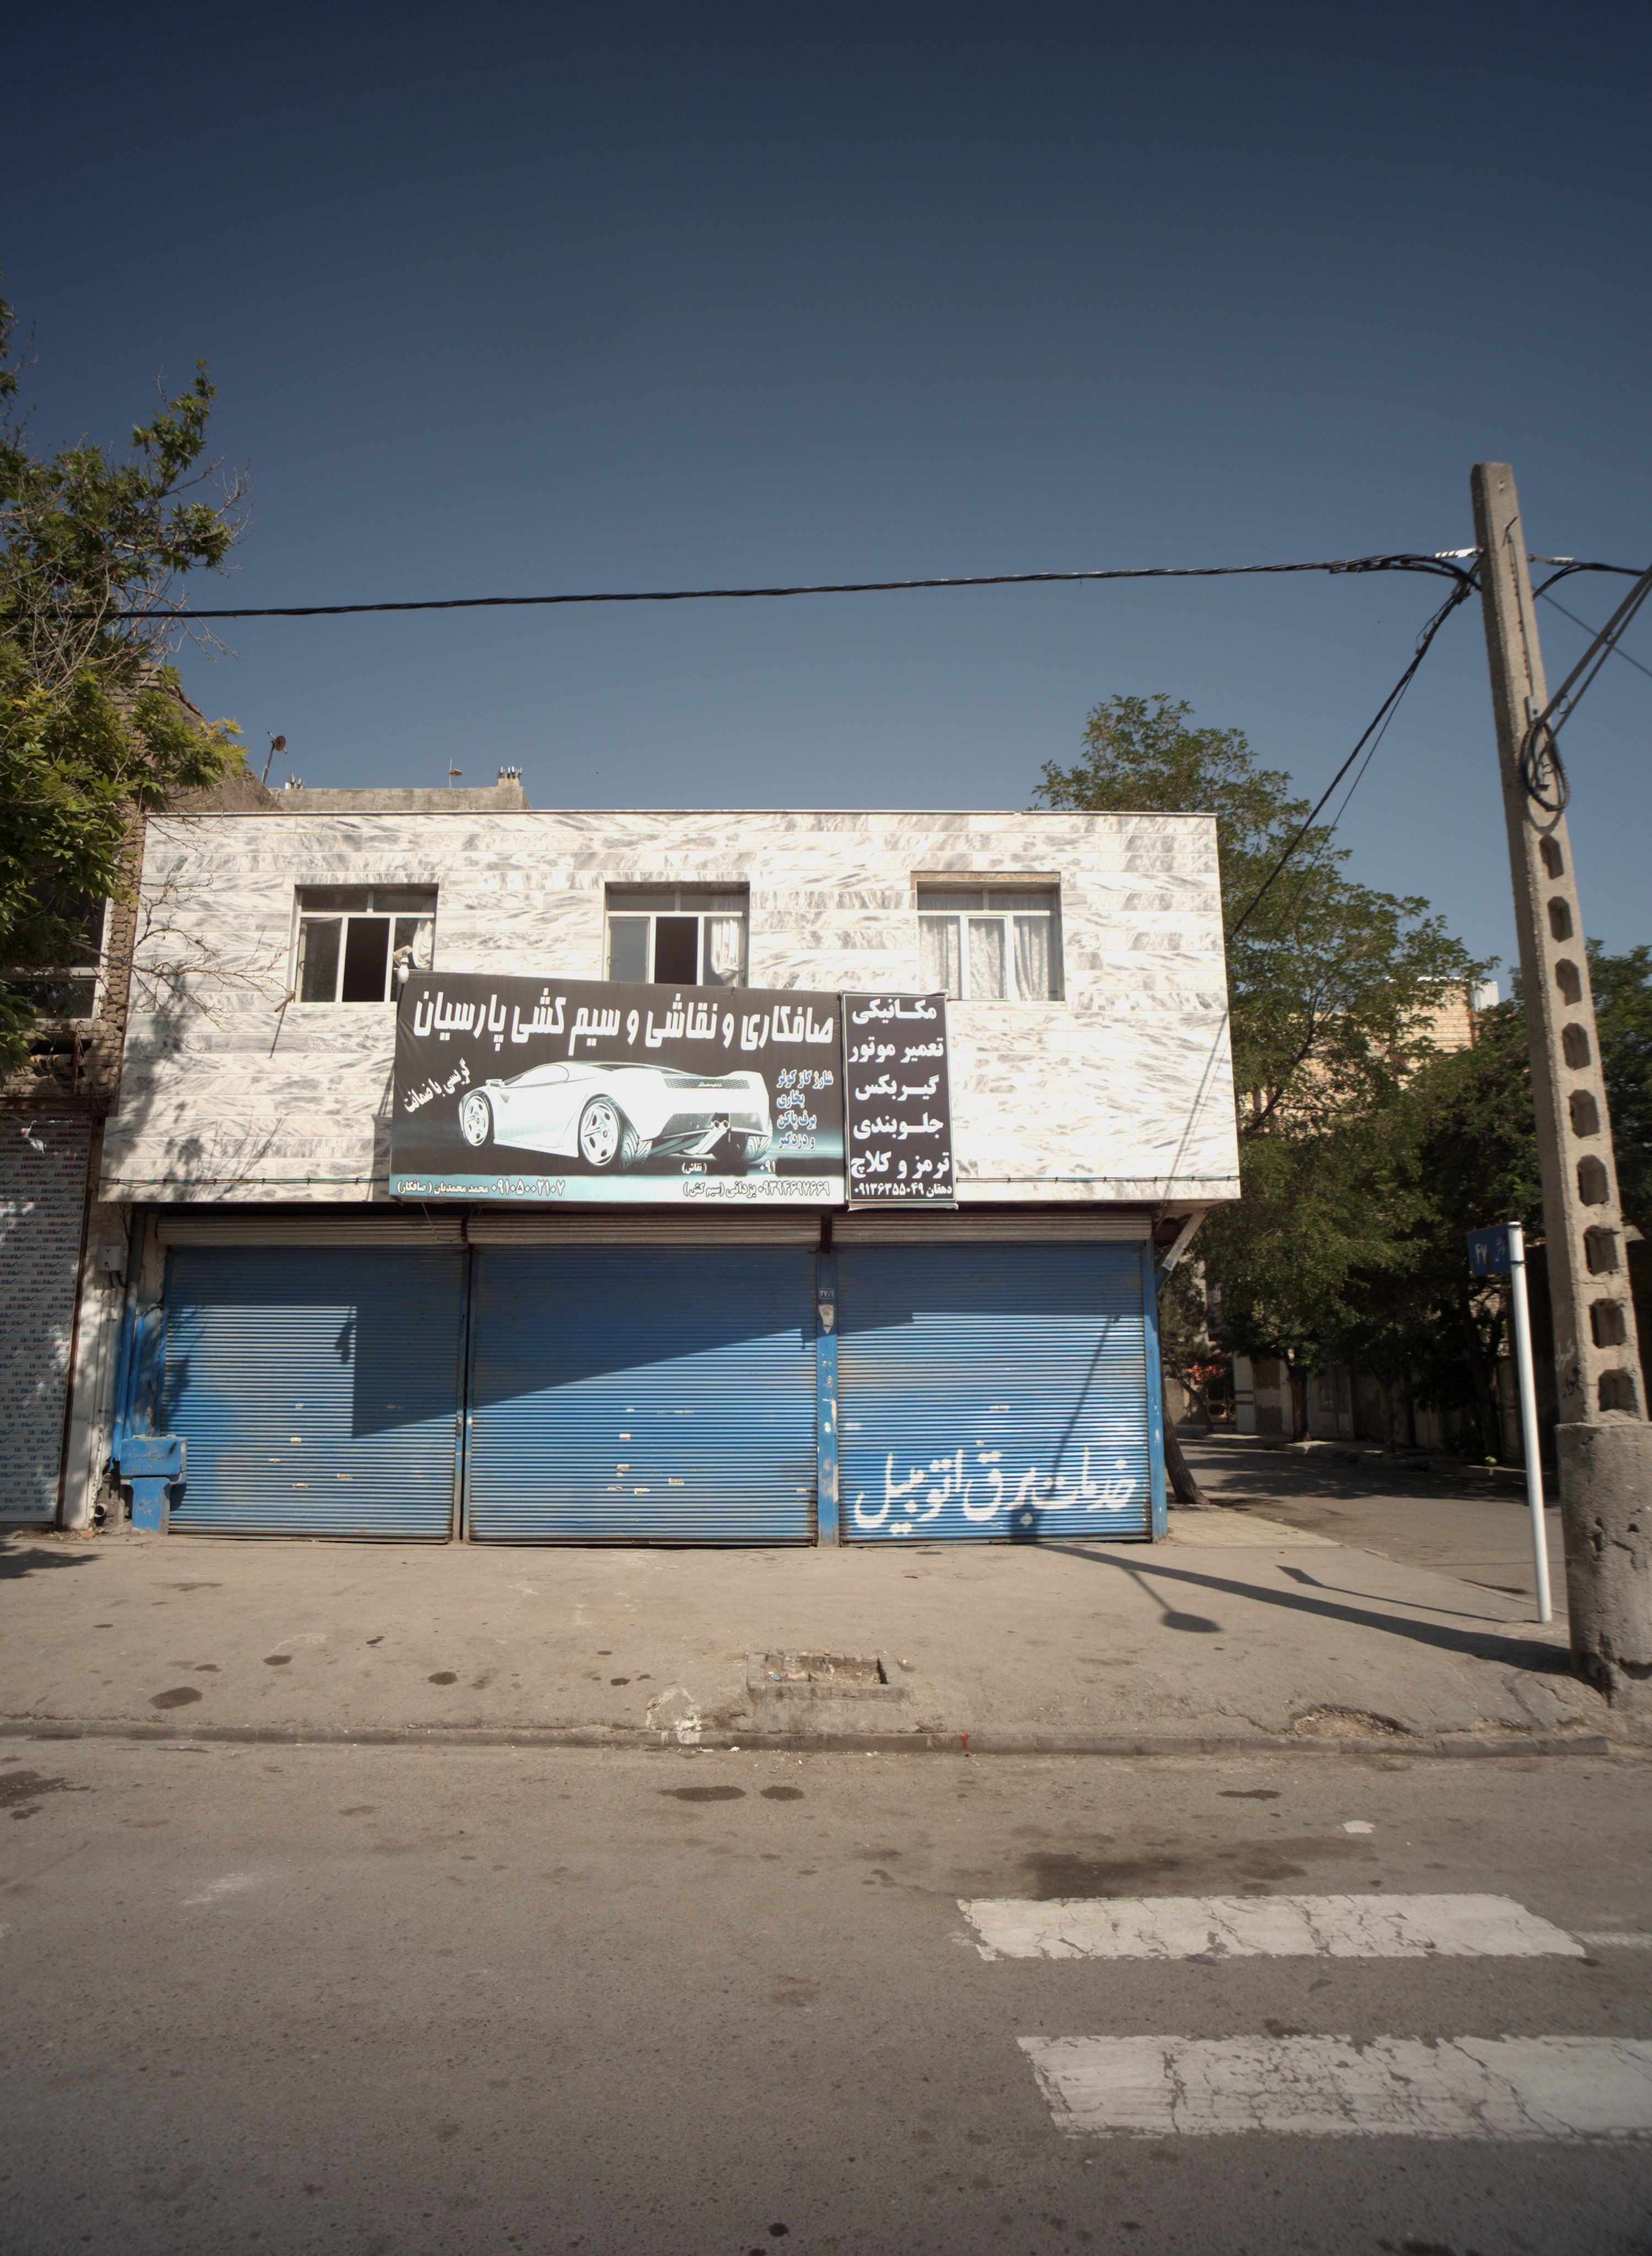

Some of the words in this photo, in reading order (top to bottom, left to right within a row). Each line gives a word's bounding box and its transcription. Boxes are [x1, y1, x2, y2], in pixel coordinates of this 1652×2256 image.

[414, 991, 507, 1051] پارسیان
[511, 988, 567, 1043] کشی
[645, 993, 718, 1048] نقاشی
[852, 998, 937, 1024] مکانیکی
[568, 1007, 621, 1056] سیم
[627, 1009, 639, 1045] و
[722, 1012, 735, 1049] و
[741, 1005, 834, 1051] صافکاری
[848, 1036, 896, 1063] موتور
[900, 1037, 944, 1064] تعمیر
[428, 1077, 446, 1098] با
[776, 1068, 797, 1088] کولر
[797, 1069, 812, 1089] گاز
[812, 1070, 834, 1089] شارژ
[855, 1073, 940, 1102] گیربکس
[404, 1083, 434, 1113] ضمانت
[776, 1089, 805, 1109] بخاری
[798, 1109, 817, 1130] برف
[854, 1111, 944, 1140] جلوبندی
[778, 1131, 808, 1151] دزدگیر
[809, 1136, 816, 1151] و
[850, 1150, 893, 1178] کلاچ
[896, 1159, 908, 1180] و
[912, 1151, 950, 1179] ترمز
[926, 1183, 953, 1198] دهقان
[854, 1449, 964, 1534] اتومبیل
[963, 1450, 1037, 1527] برق
[1031, 1446, 1137, 1511] خدمات
